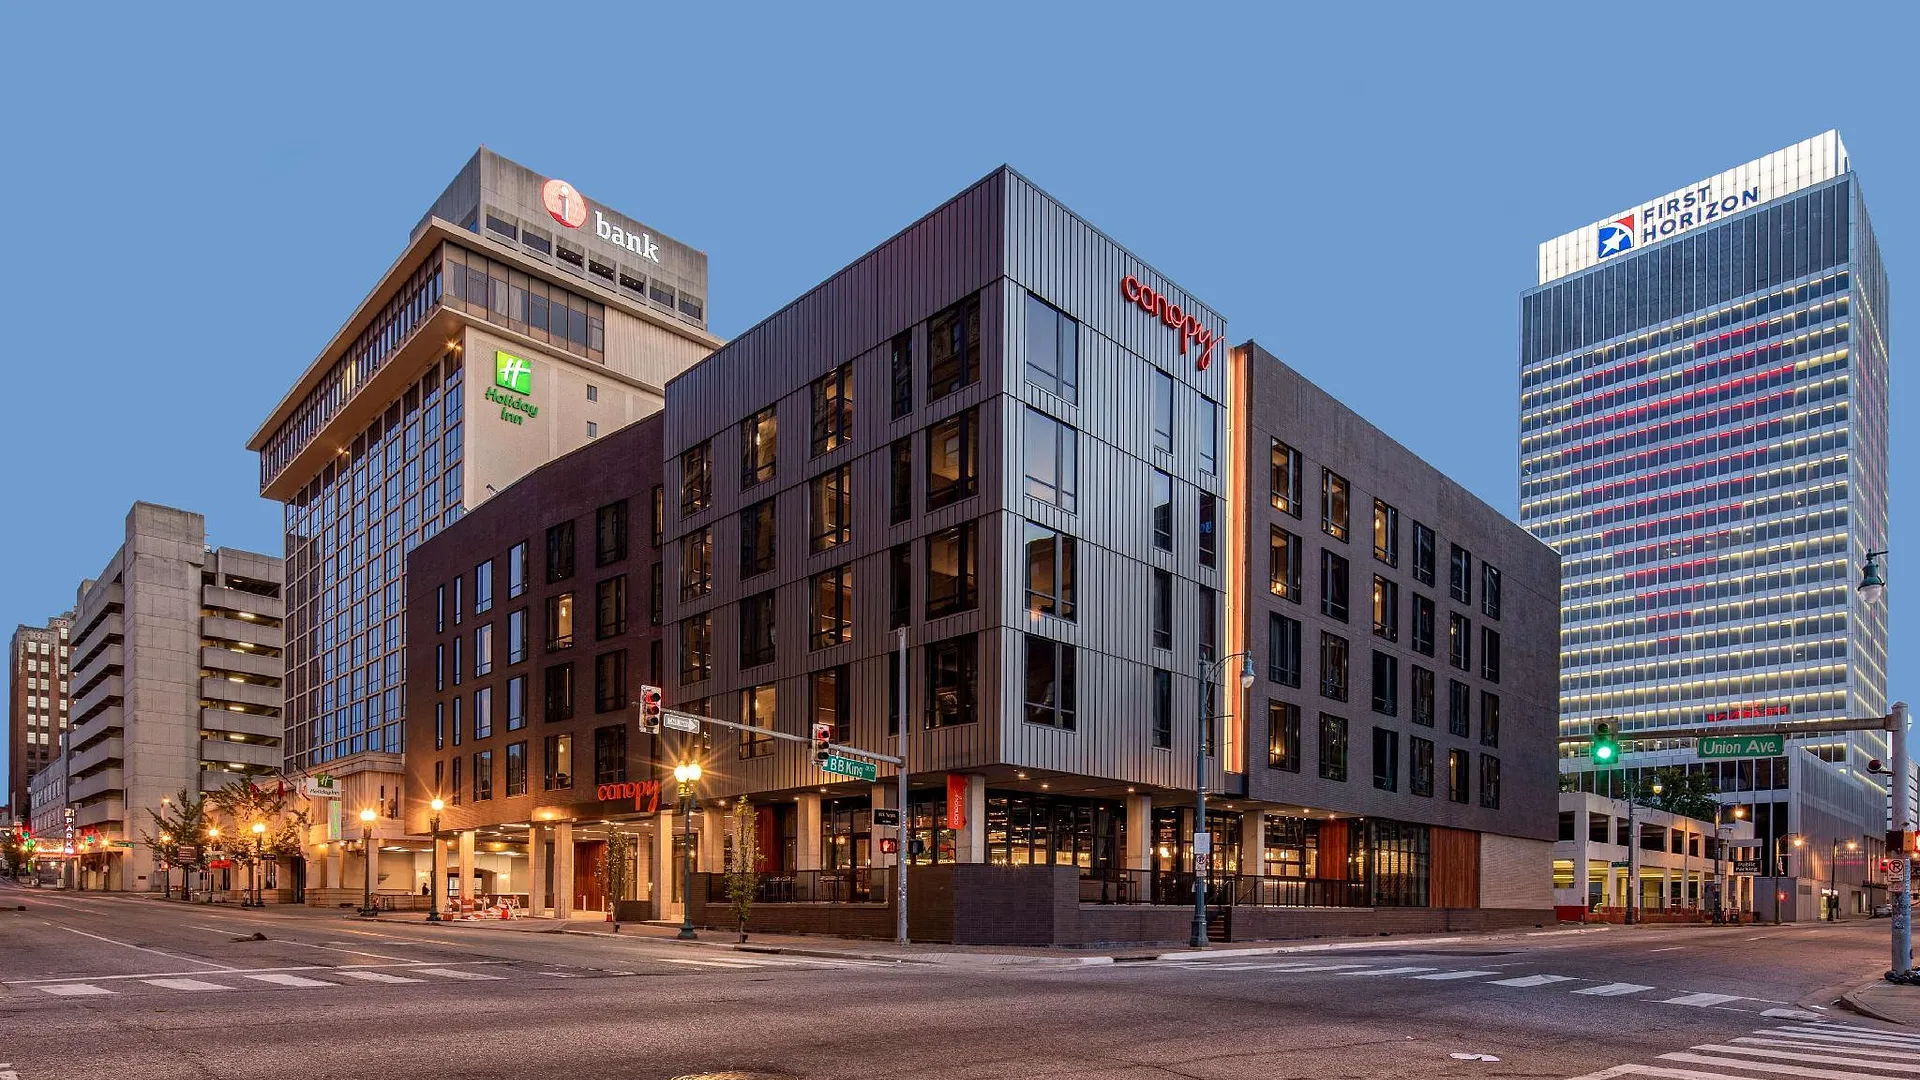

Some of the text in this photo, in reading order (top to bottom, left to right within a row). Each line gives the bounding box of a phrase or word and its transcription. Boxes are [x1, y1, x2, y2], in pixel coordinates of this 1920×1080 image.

[1643, 185, 1711, 225] FIRST
[1643, 187, 1758, 243] HORIZON
[595, 209, 659, 263] bank
[1122, 274, 1226, 371] canopy
[485, 386, 540, 418] Holiday
[501, 407, 524, 426] Inn
[1703, 739, 1778, 755] Union Ave.
[846, 761, 863, 777] King
[597, 780, 659, 816] canopy
